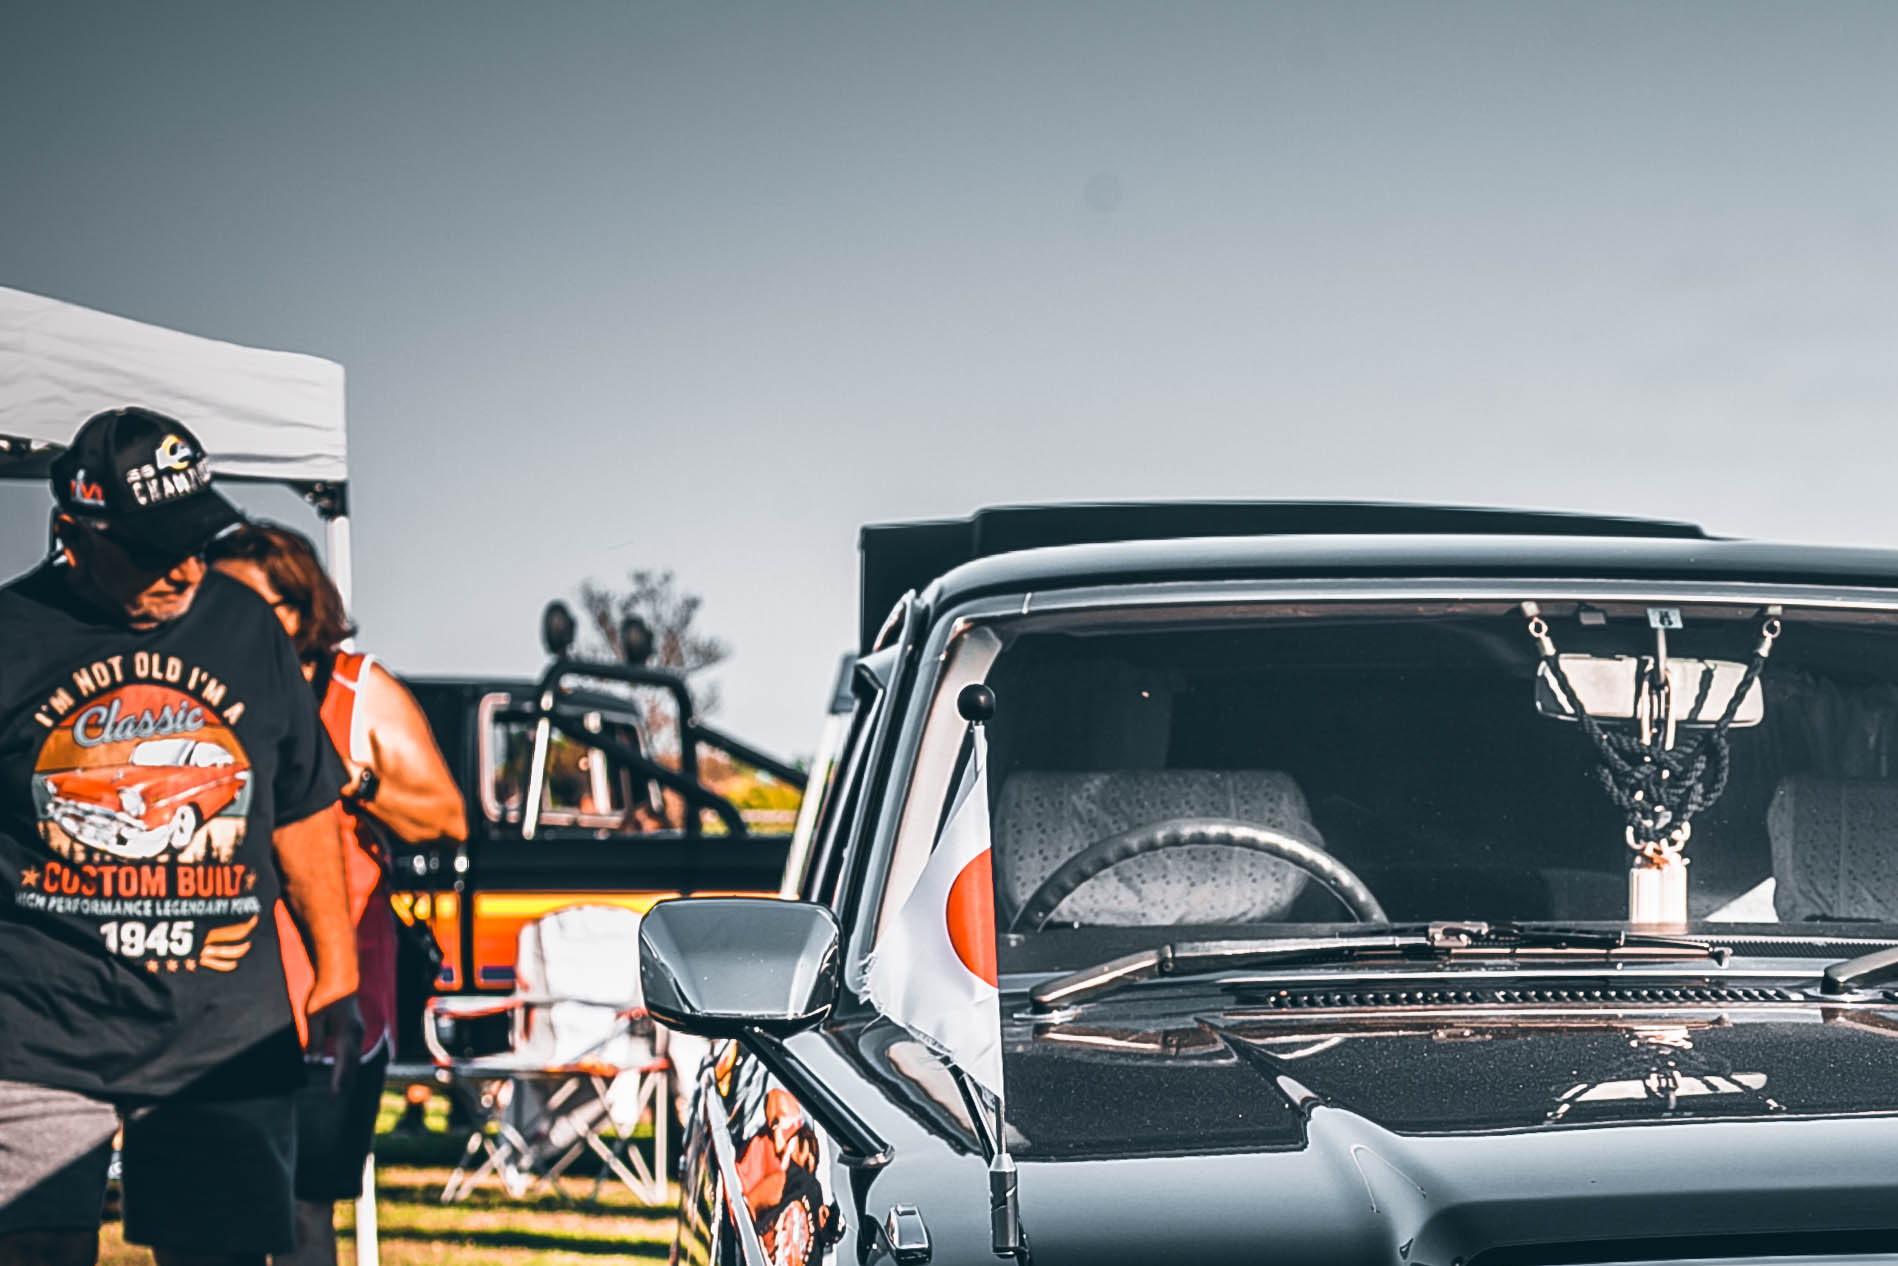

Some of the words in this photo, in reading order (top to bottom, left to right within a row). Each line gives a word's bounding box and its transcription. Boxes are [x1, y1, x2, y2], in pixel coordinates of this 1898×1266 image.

[34, 687, 75, 728] I'M
[72, 655, 124, 697] NOT
[134, 651, 183, 683] OLD
[187, 667, 227, 707] I'M
[222, 701, 245, 726] A
[72, 698, 204, 748] Classic
[43, 861, 167, 897] CUSTOM
[176, 864, 246, 897] BUILT
[47, 896, 151, 917] PERFORMANCE
[155, 898, 228, 917] LEGENDARY
[100, 920, 195, 957] 1945
